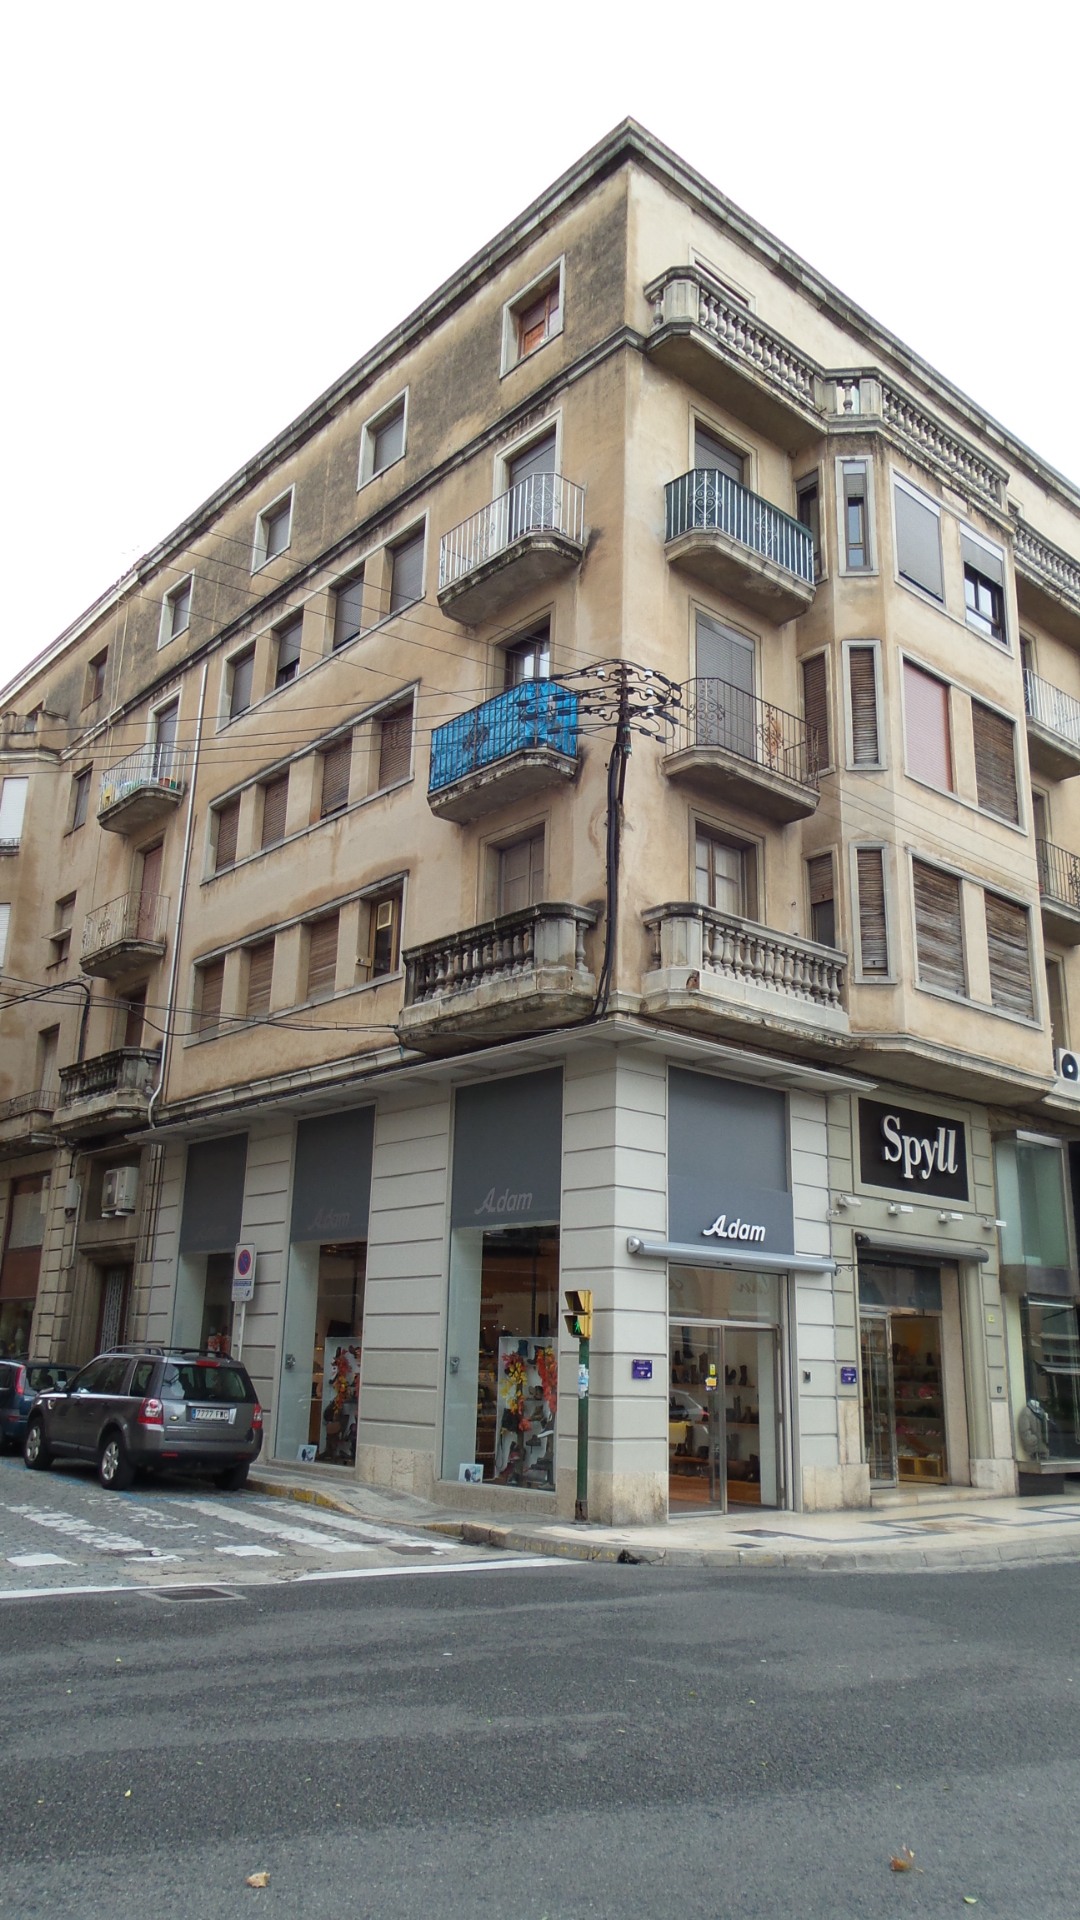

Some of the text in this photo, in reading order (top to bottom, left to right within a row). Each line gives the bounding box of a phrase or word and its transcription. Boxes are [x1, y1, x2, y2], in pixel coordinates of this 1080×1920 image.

[882, 1114, 958, 1180] Spyll
[474, 1186, 533, 1215] Adam
[702, 1214, 766, 1242] Adam
